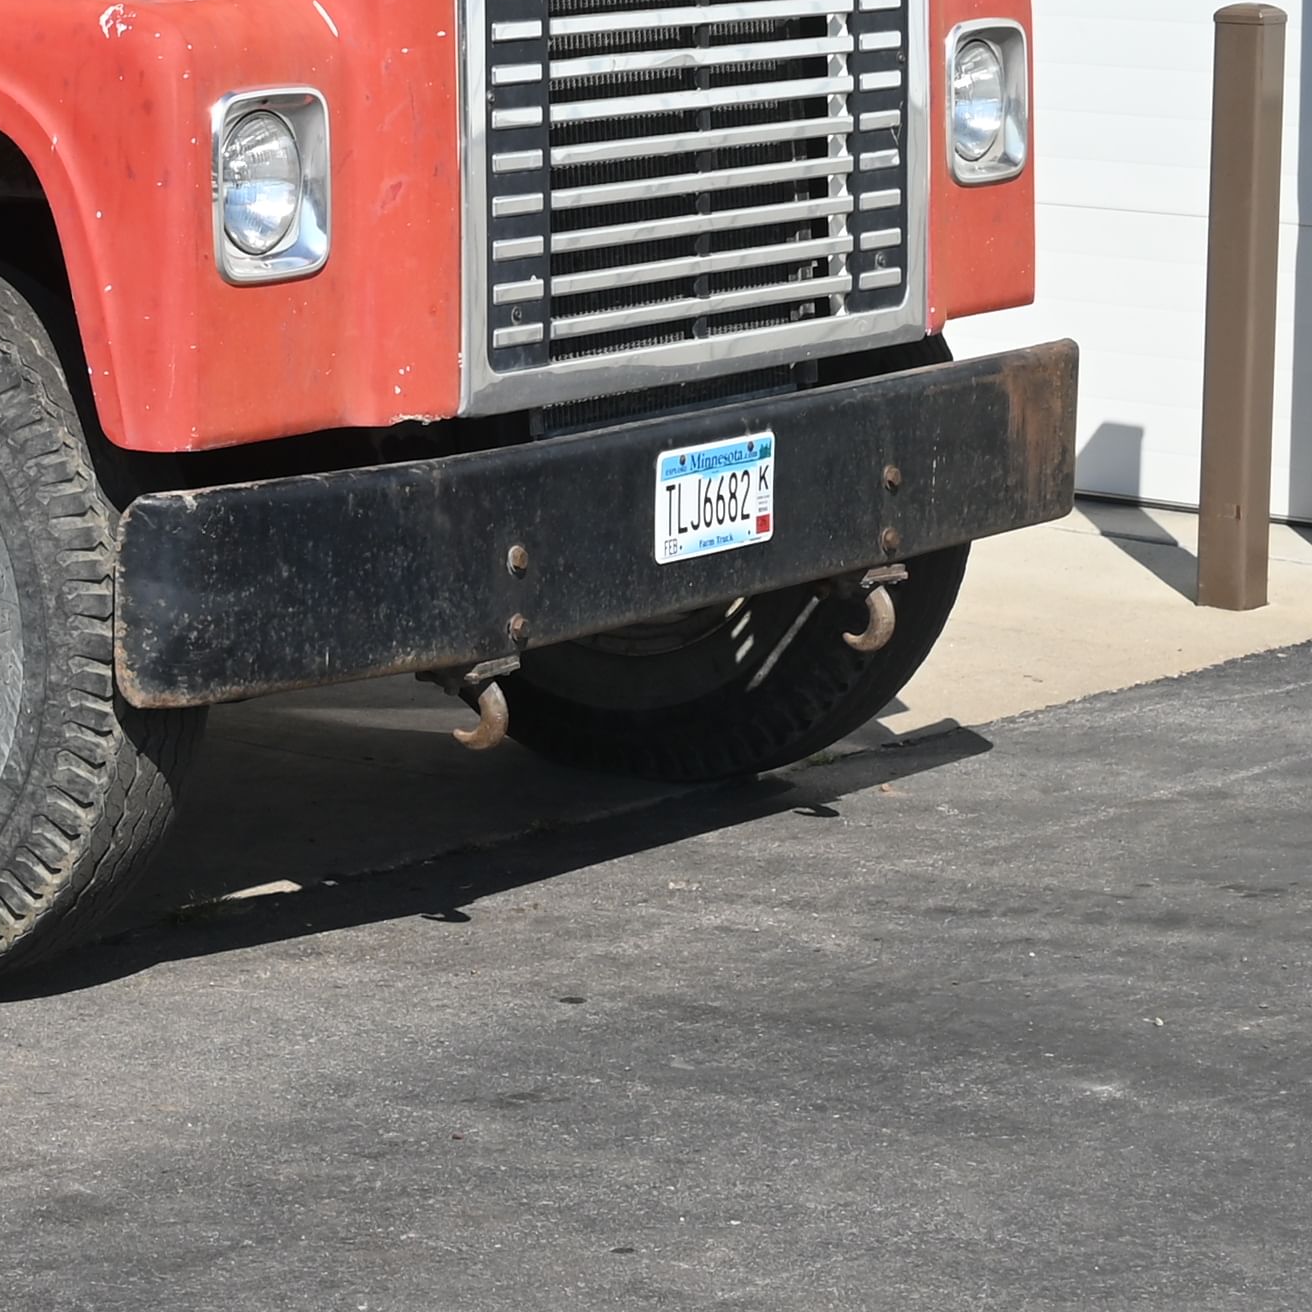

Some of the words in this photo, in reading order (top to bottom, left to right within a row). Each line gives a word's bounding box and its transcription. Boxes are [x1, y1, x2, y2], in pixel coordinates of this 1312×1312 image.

[690, 449, 743, 471] Minnesota
[666, 469, 751, 537] TLJ6682
[759, 464, 769, 491] K
[664, 538, 678, 557] FEB
